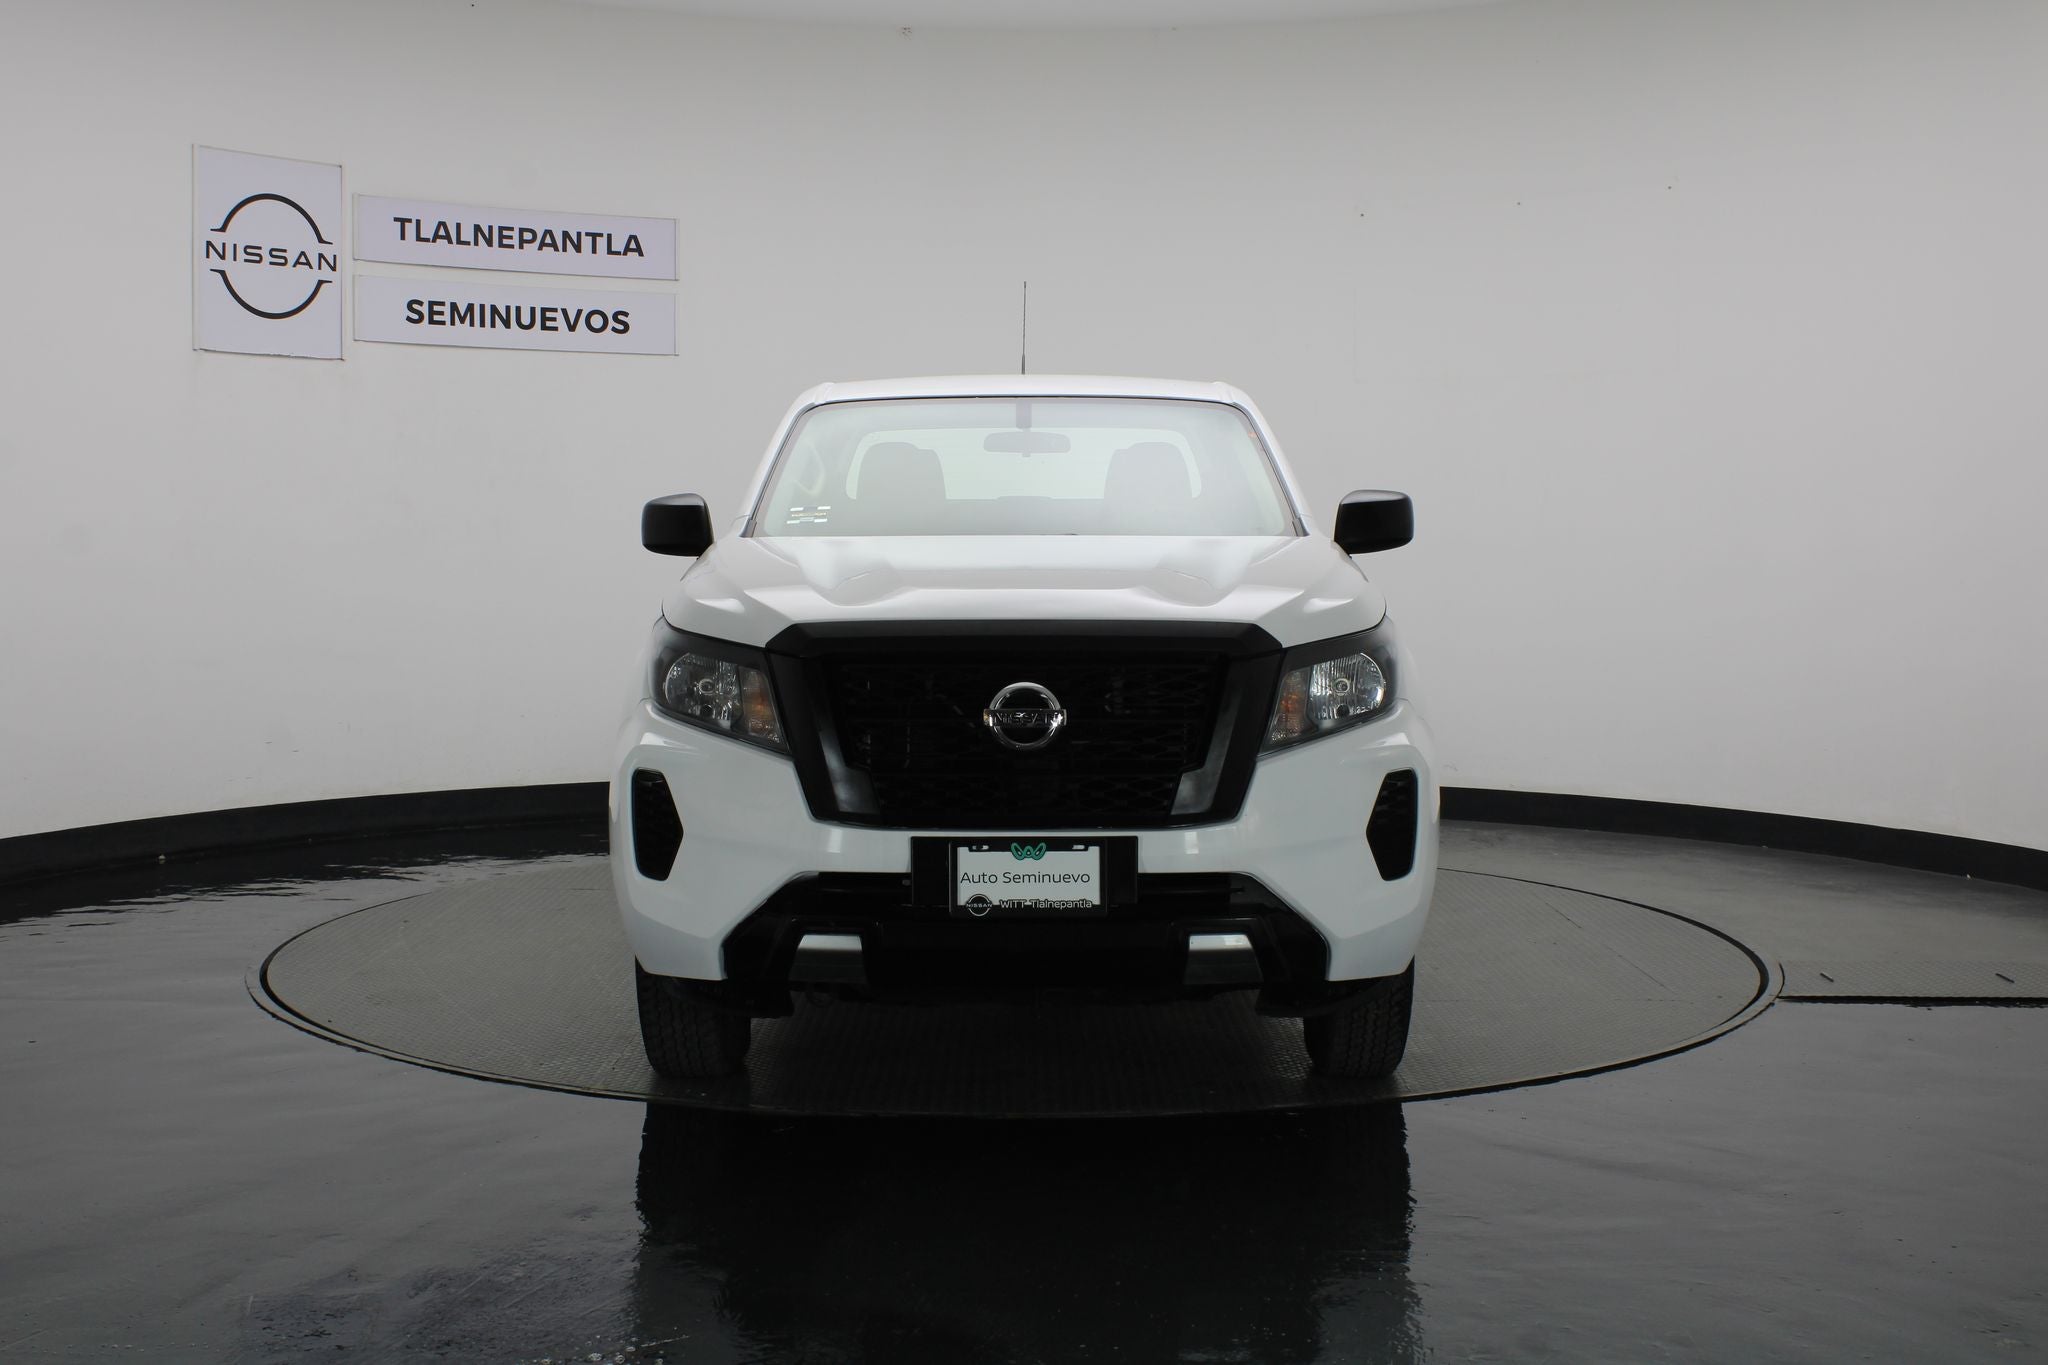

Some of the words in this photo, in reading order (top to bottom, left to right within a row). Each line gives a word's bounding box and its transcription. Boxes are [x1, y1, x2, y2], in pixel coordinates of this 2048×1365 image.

[393, 216, 645, 258] TLALNEPANTLA
[205, 239, 338, 273] NISSAN
[405, 298, 631, 335] SEMINUEVOS
[960, 871, 998, 884] Auto
[1002, 871, 1091, 884] Seminuevo
[1000, 899, 1026, 909] WITT
[1030, 898, 1093, 910] Tlalnepantla
